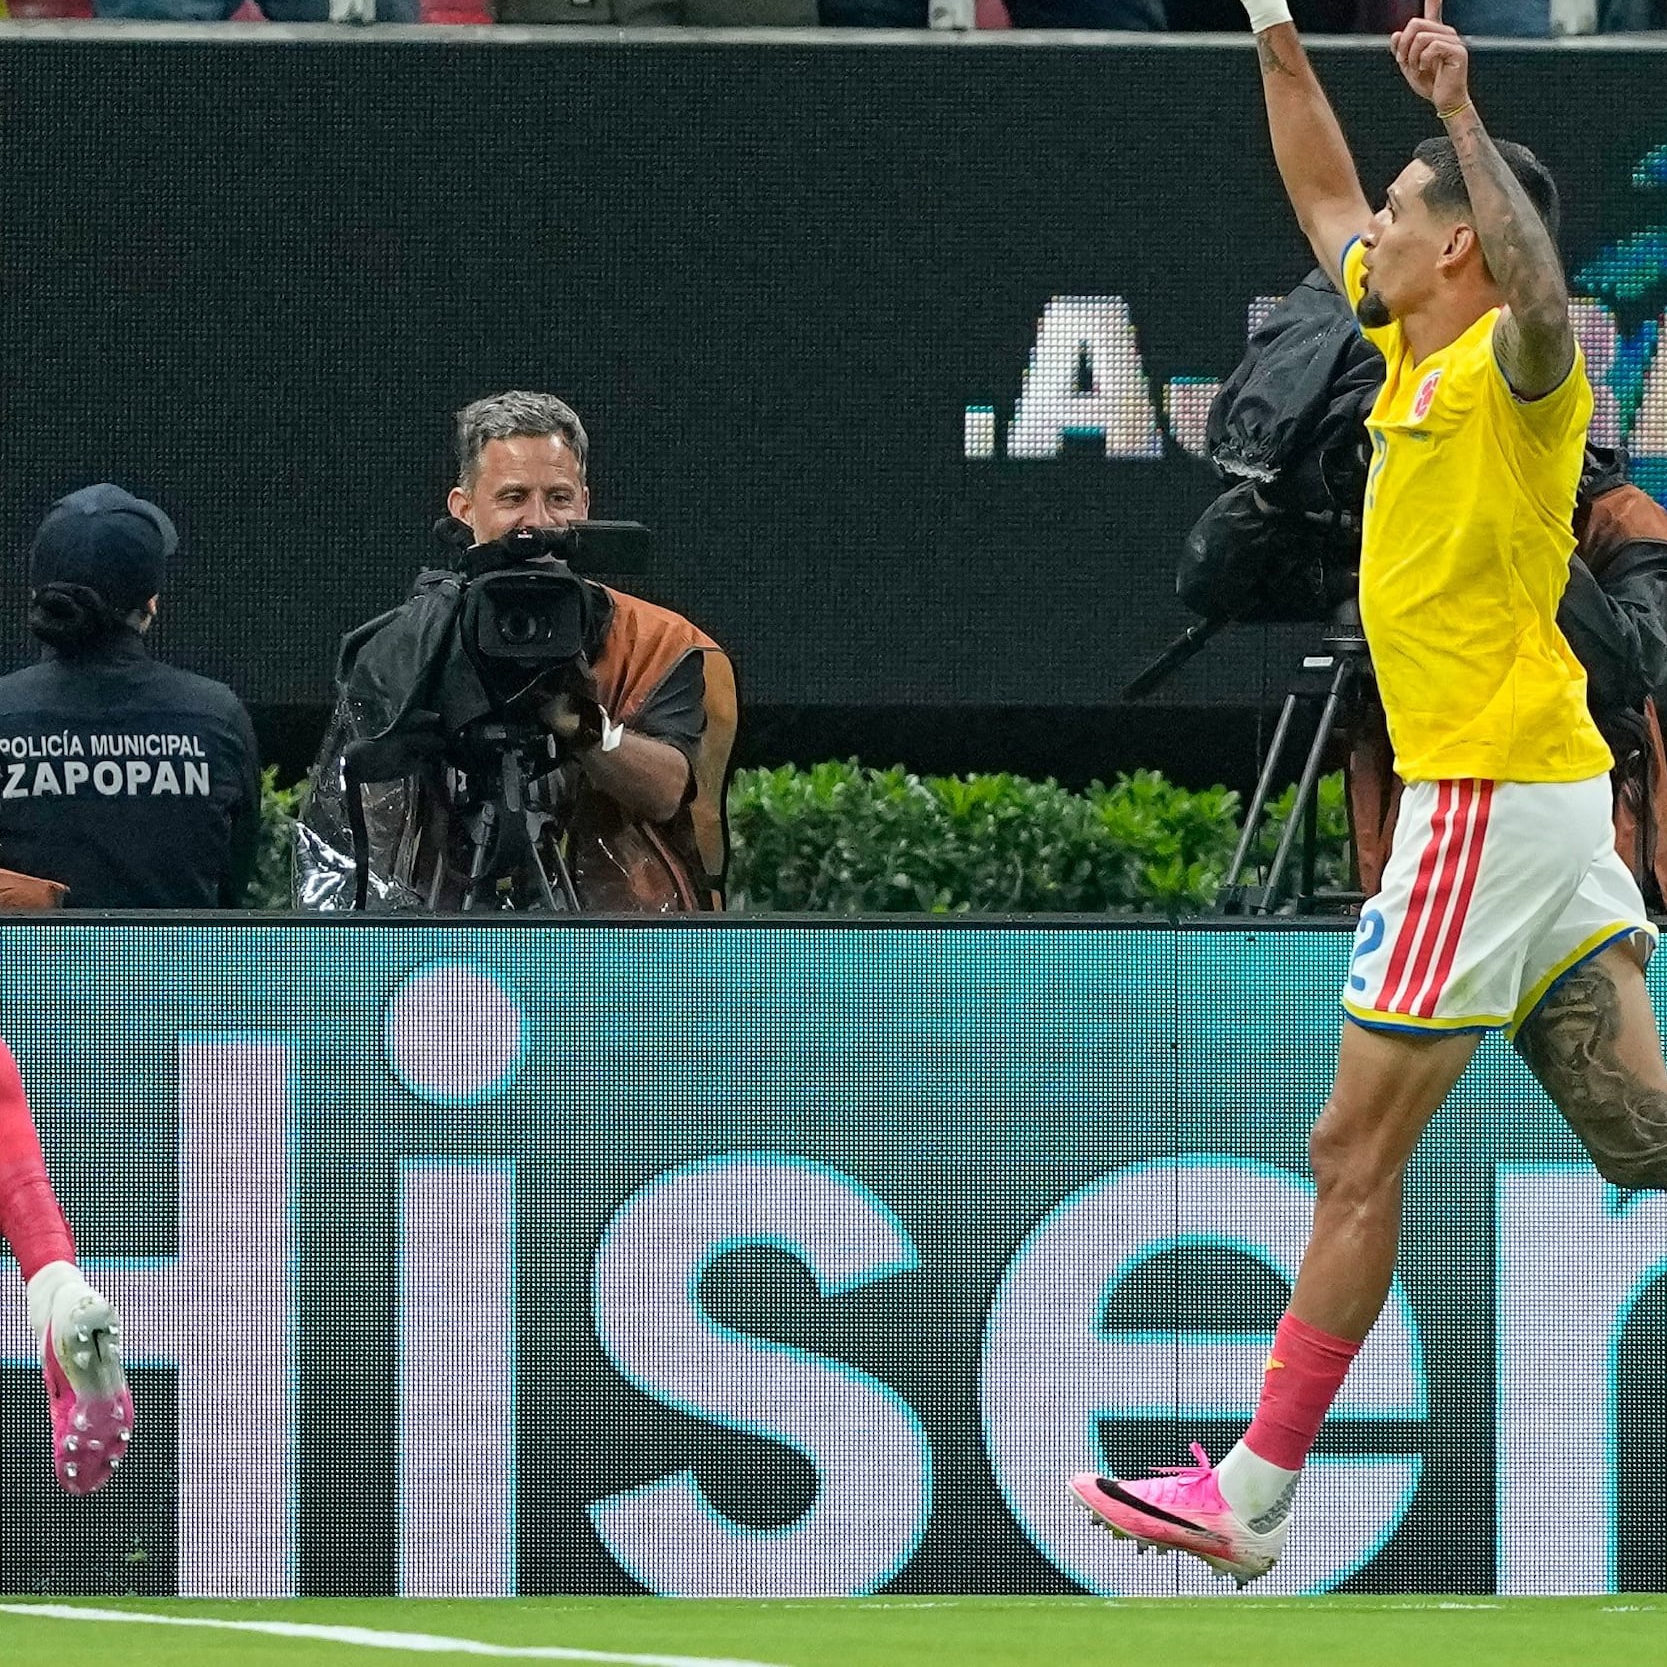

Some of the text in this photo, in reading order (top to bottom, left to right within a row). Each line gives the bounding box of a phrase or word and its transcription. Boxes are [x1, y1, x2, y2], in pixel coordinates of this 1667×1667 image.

[0, 729, 206, 759] POLICÍA MUNICIPAL
[2, 759, 211, 800] ZAPOPAN
[1350, 908, 1386, 992] 2
